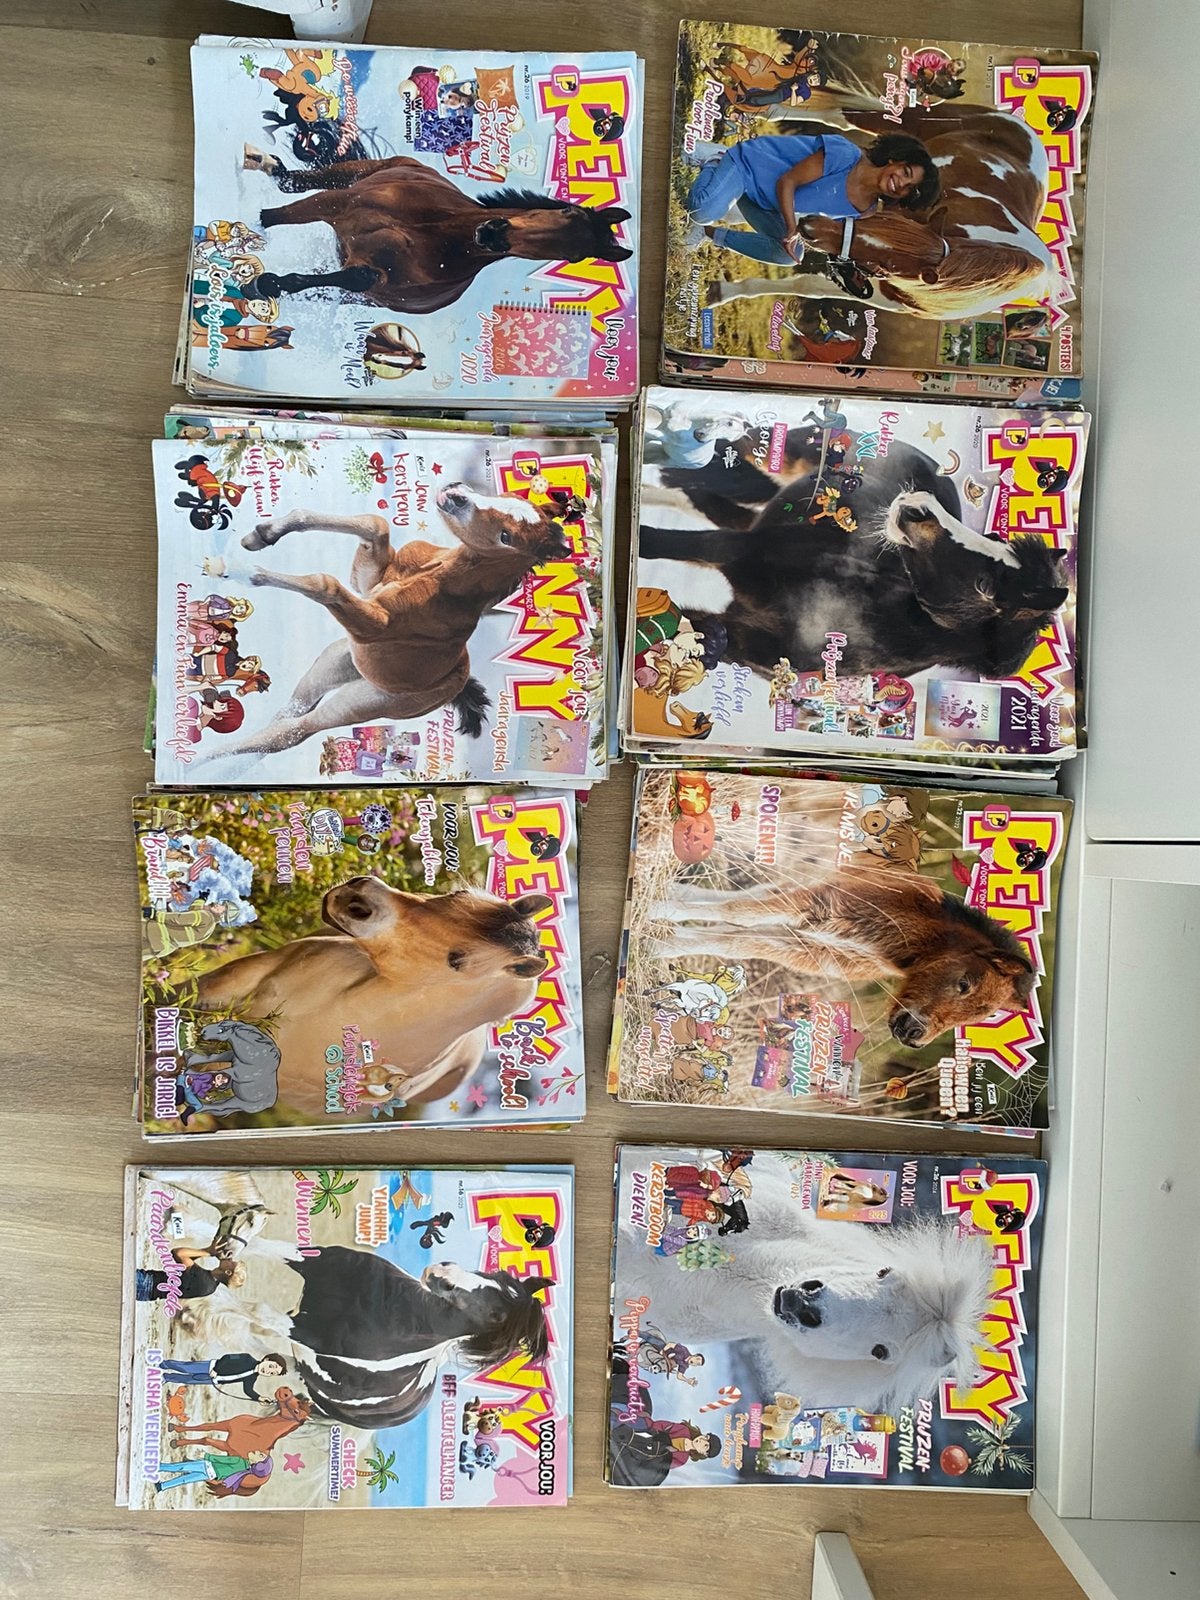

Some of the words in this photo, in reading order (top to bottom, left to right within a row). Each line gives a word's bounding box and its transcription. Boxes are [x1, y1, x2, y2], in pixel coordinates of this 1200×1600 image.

[332, 57, 355, 84] De
[414, 98, 424, 120] Win
[692, 101, 706, 126] voor
[702, 79, 724, 141] Problemen
[879, 73, 905, 124] pony?!
[336, 84, 359, 156] wisseltruc
[403, 91, 414, 144] ponykamp!
[477, 100, 499, 171] Festival
[497, 105, 519, 165] Prijzen
[558, 137, 568, 160] VOOR
[684, 124, 702, 154] Finn
[559, 163, 568, 184] PONY
[560, 187, 568, 199] EN
[206, 264, 229, 300] Lois
[692, 263, 704, 281] Een
[207, 301, 227, 317] is
[676, 288, 689, 312] kistje
[686, 282, 702, 338] geheimzinnig
[864, 309, 876, 325] Van
[204, 316, 228, 370] jaloers
[344, 341, 356, 352] is
[354, 319, 376, 357] Waar
[478, 312, 500, 383] Jaaragenda
[601, 317, 624, 352] Voor
[703, 312, 713, 346] Leesverhaal
[766, 316, 784, 352] lieveling
[460, 352, 479, 384] 2020
[597, 352, 621, 381] jou:
[1059, 334, 1072, 372] POSTERS!
[752, 410, 777, 467] George
[770, 424, 786, 472] DROOMPAARD
[856, 431, 878, 462] XXL
[878, 410, 900, 457] Rakker
[972, 434, 980, 449] 2020
[246, 447, 266, 477] blijf
[415, 455, 426, 472] Kwis
[250, 480, 270, 518] staan!
[414, 480, 430, 513] Jouw
[1000, 487, 1009, 510] VOOR
[1000, 513, 1010, 534] PONY
[174, 582, 192, 632] Emma
[525, 583, 534, 612] PAARD!
[176, 633, 188, 653] en
[174, 656, 192, 693] Finn
[571, 650, 591, 686] Voor
[821, 632, 848, 734] Prijzenfestival!
[568, 688, 589, 716] jou:
[711, 670, 732, 727] verliefd
[730, 662, 752, 714] Stiekem
[784, 716, 793, 728] EEN
[980, 704, 989, 722] 2021
[1009, 696, 1028, 731] 2021
[1026, 679, 1046, 747] Jaaragenda
[1047, 696, 1062, 721] Voor
[166, 694, 196, 764] verliefd?
[442, 709, 455, 768] PRIJZEN-
[491, 690, 513, 773] Jaaragenda
[1044, 721, 1062, 747] jou!
[426, 720, 441, 777] FESTIVAL
[842, 790, 859, 809] IK
[956, 800, 964, 816] nr.22
[288, 802, 312, 870] Paarden
[313, 814, 333, 836] DIY
[442, 802, 458, 840] VOOR
[754, 786, 781, 864] SPOKEN!!!
[840, 811, 856, 839] MIS
[268, 828, 293, 883] pennen
[410, 795, 441, 886] Tekensjabloon
[443, 840, 460, 872] JOU:
[140, 834, 172, 900] Brand!!!
[496, 858, 506, 880] VOOR
[980, 865, 988, 886] VOOR
[978, 889, 987, 910] PONY
[156, 1008, 179, 1052] BIKKEL
[500, 1032, 517, 1050] to
[514, 1018, 546, 1067] Back
[653, 1008, 680, 1058] Spetter
[811, 1002, 830, 1084] PRIJZEN-
[156, 1056, 176, 1072] IS
[338, 1024, 360, 1115] Paardengek
[364, 1044, 372, 1060] Kwis
[634, 1026, 656, 1091] mascotte!
[652, 1061, 671, 1075] is
[792, 1019, 813, 1099] FESTIVAL
[497, 1052, 530, 1110] school!
[938, 1058, 956, 1117] Queen?
[955, 1038, 972, 1113] Halloween
[972, 1082, 986, 1093] jij
[974, 1061, 987, 1081] Ben
[154, 1076, 180, 1119] JARIG!
[325, 1068, 346, 1113] School
[974, 1096, 984, 1116] een
[988, 1086, 996, 1102] Kwis
[802, 1160, 814, 1210] JAARAGENDA
[814, 1160, 824, 1183] MINI-
[902, 1160, 918, 1185] VOOR
[630, 1170, 648, 1229] DIEVEN!
[647, 1160, 666, 1247] KERSTBOOM
[790, 1182, 800, 1200] 2025
[900, 1186, 915, 1208] JOU:
[172, 1216, 184, 1236] Kwis
[295, 1180, 320, 1257] Winnen!
[356, 1204, 372, 1244] JUMP!
[370, 1186, 388, 1246] YIAHHHH,
[148, 1189, 186, 1319] Paardenliefde
[489, 1244, 499, 1266] VOOR
[620, 1297, 649, 1339] Pippa
[146, 1349, 162, 1365] IS
[146, 1367, 160, 1408] AISHA
[442, 1374, 456, 1398] BFF
[617, 1354, 650, 1424] verdrietig
[143, 1414, 160, 1483] VERLIEFD?
[440, 1400, 456, 1500] SLEUTELHANGER
[540, 1422, 554, 1462] VOOR
[898, 1406, 916, 1474] FESTIVAL
[916, 1398, 933, 1473] PRIJZEN-
[328, 1426, 342, 1500] SUMMERTIME!
[341, 1438, 356, 1489] CHECK
[539, 1463, 554, 1495] JOU:
